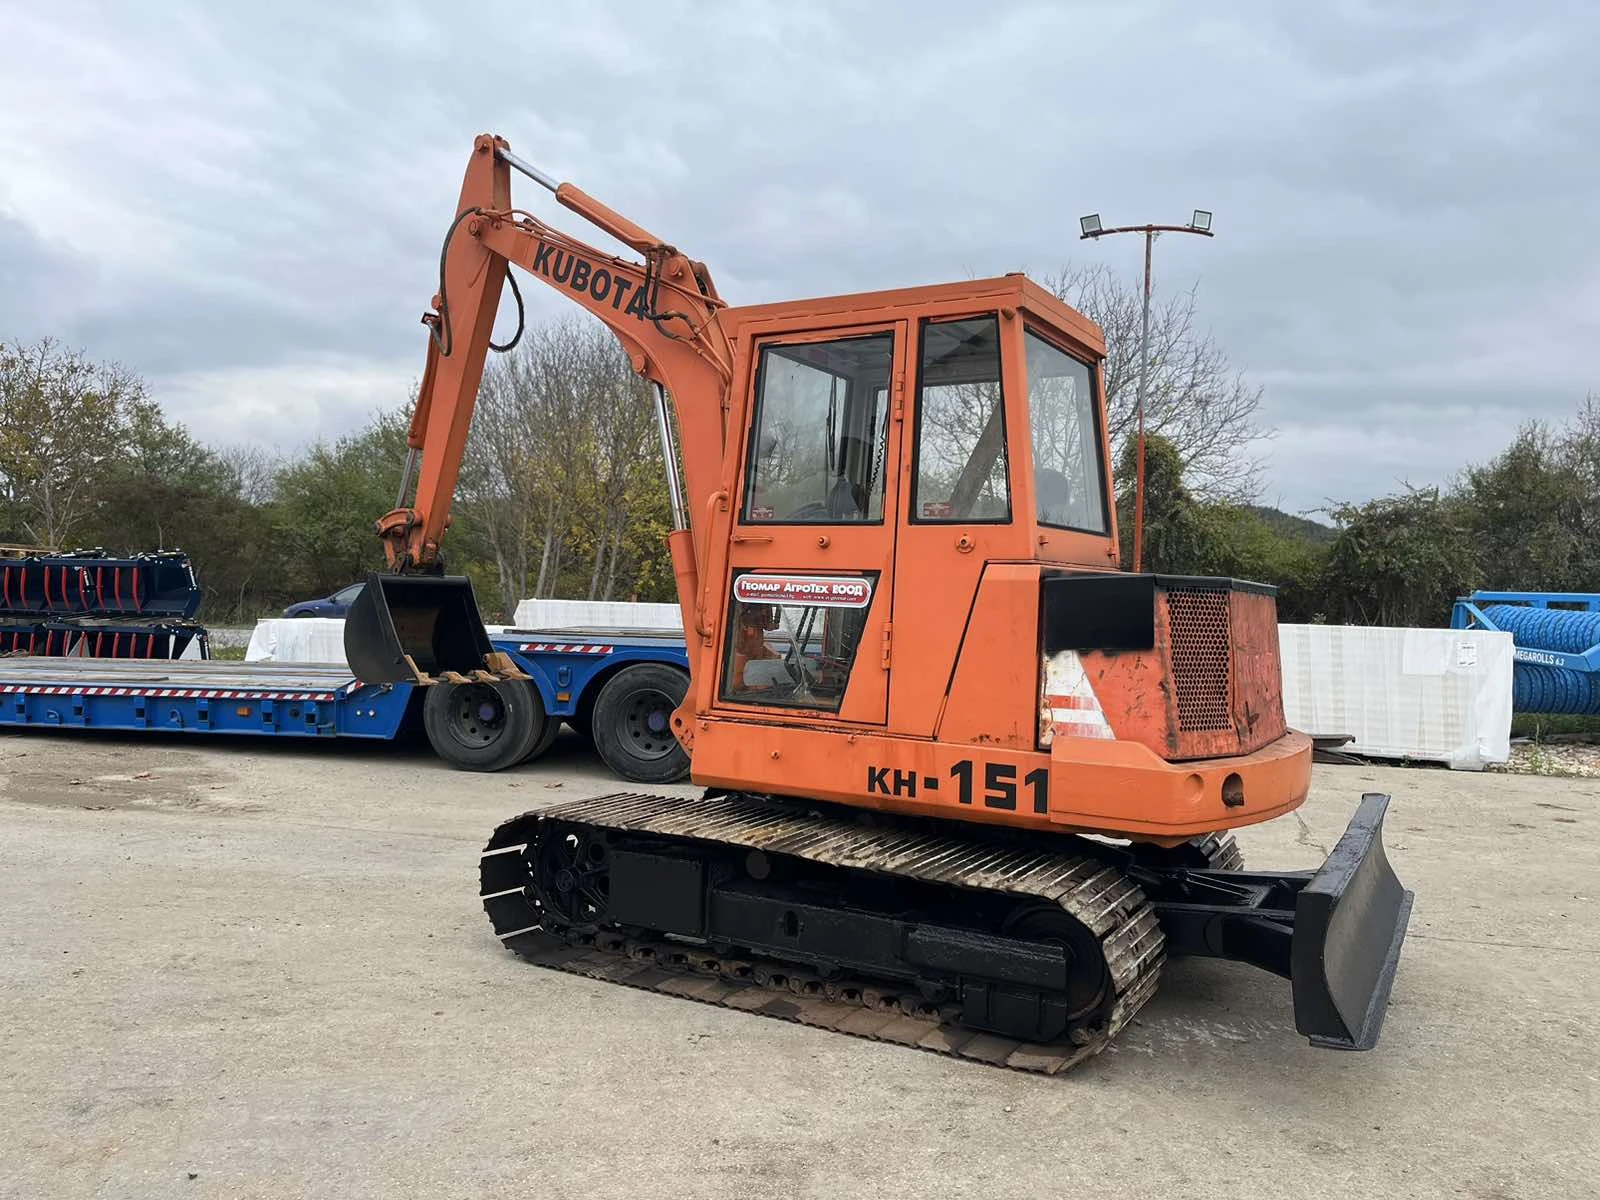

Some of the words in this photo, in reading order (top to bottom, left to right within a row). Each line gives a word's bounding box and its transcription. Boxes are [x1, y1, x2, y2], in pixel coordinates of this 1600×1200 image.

[532, 240, 645, 322] KUBOTA
[832, 585, 863, 596] ЕООД
[1514, 650, 1554, 665] MEGAROLLS
[868, 759, 1049, 815] KH-151
